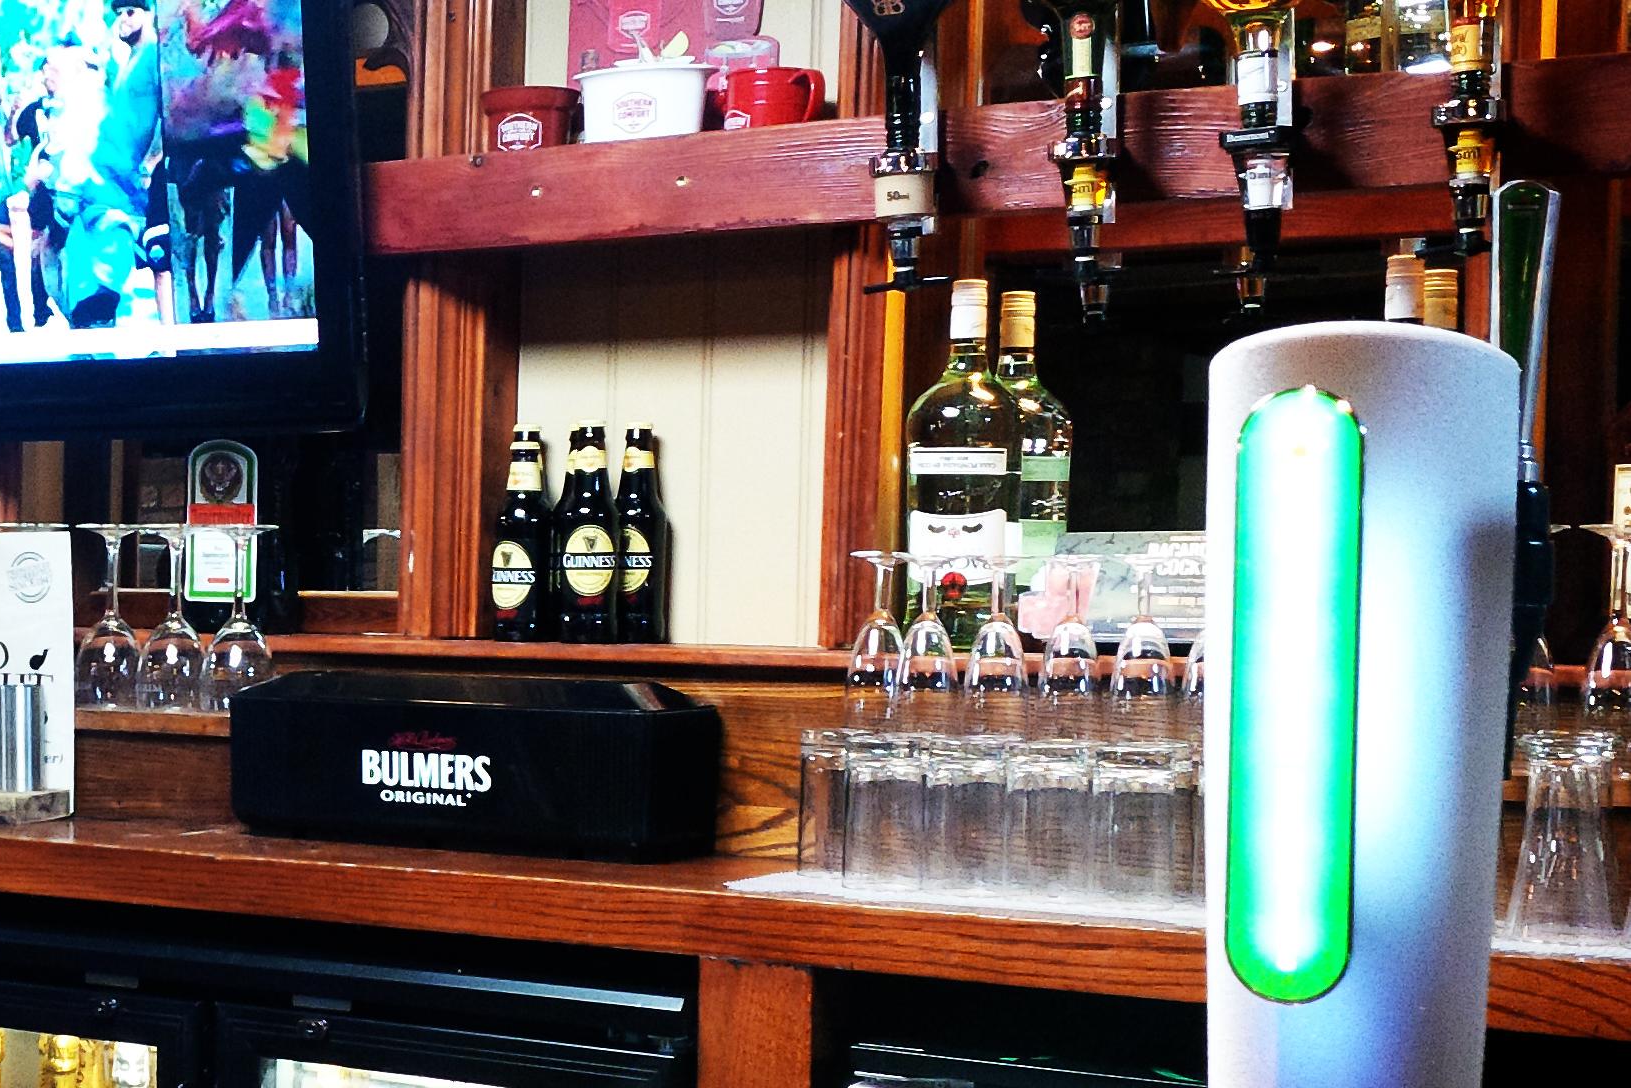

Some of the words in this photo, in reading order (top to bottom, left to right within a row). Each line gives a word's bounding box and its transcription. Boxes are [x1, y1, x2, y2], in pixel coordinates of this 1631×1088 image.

[618, 110, 650, 120] COMFORT
[562, 553, 616, 569] GUINNESS
[361, 749, 492, 793] BULMERS
[379, 789, 468, 807] ORIGINAL
